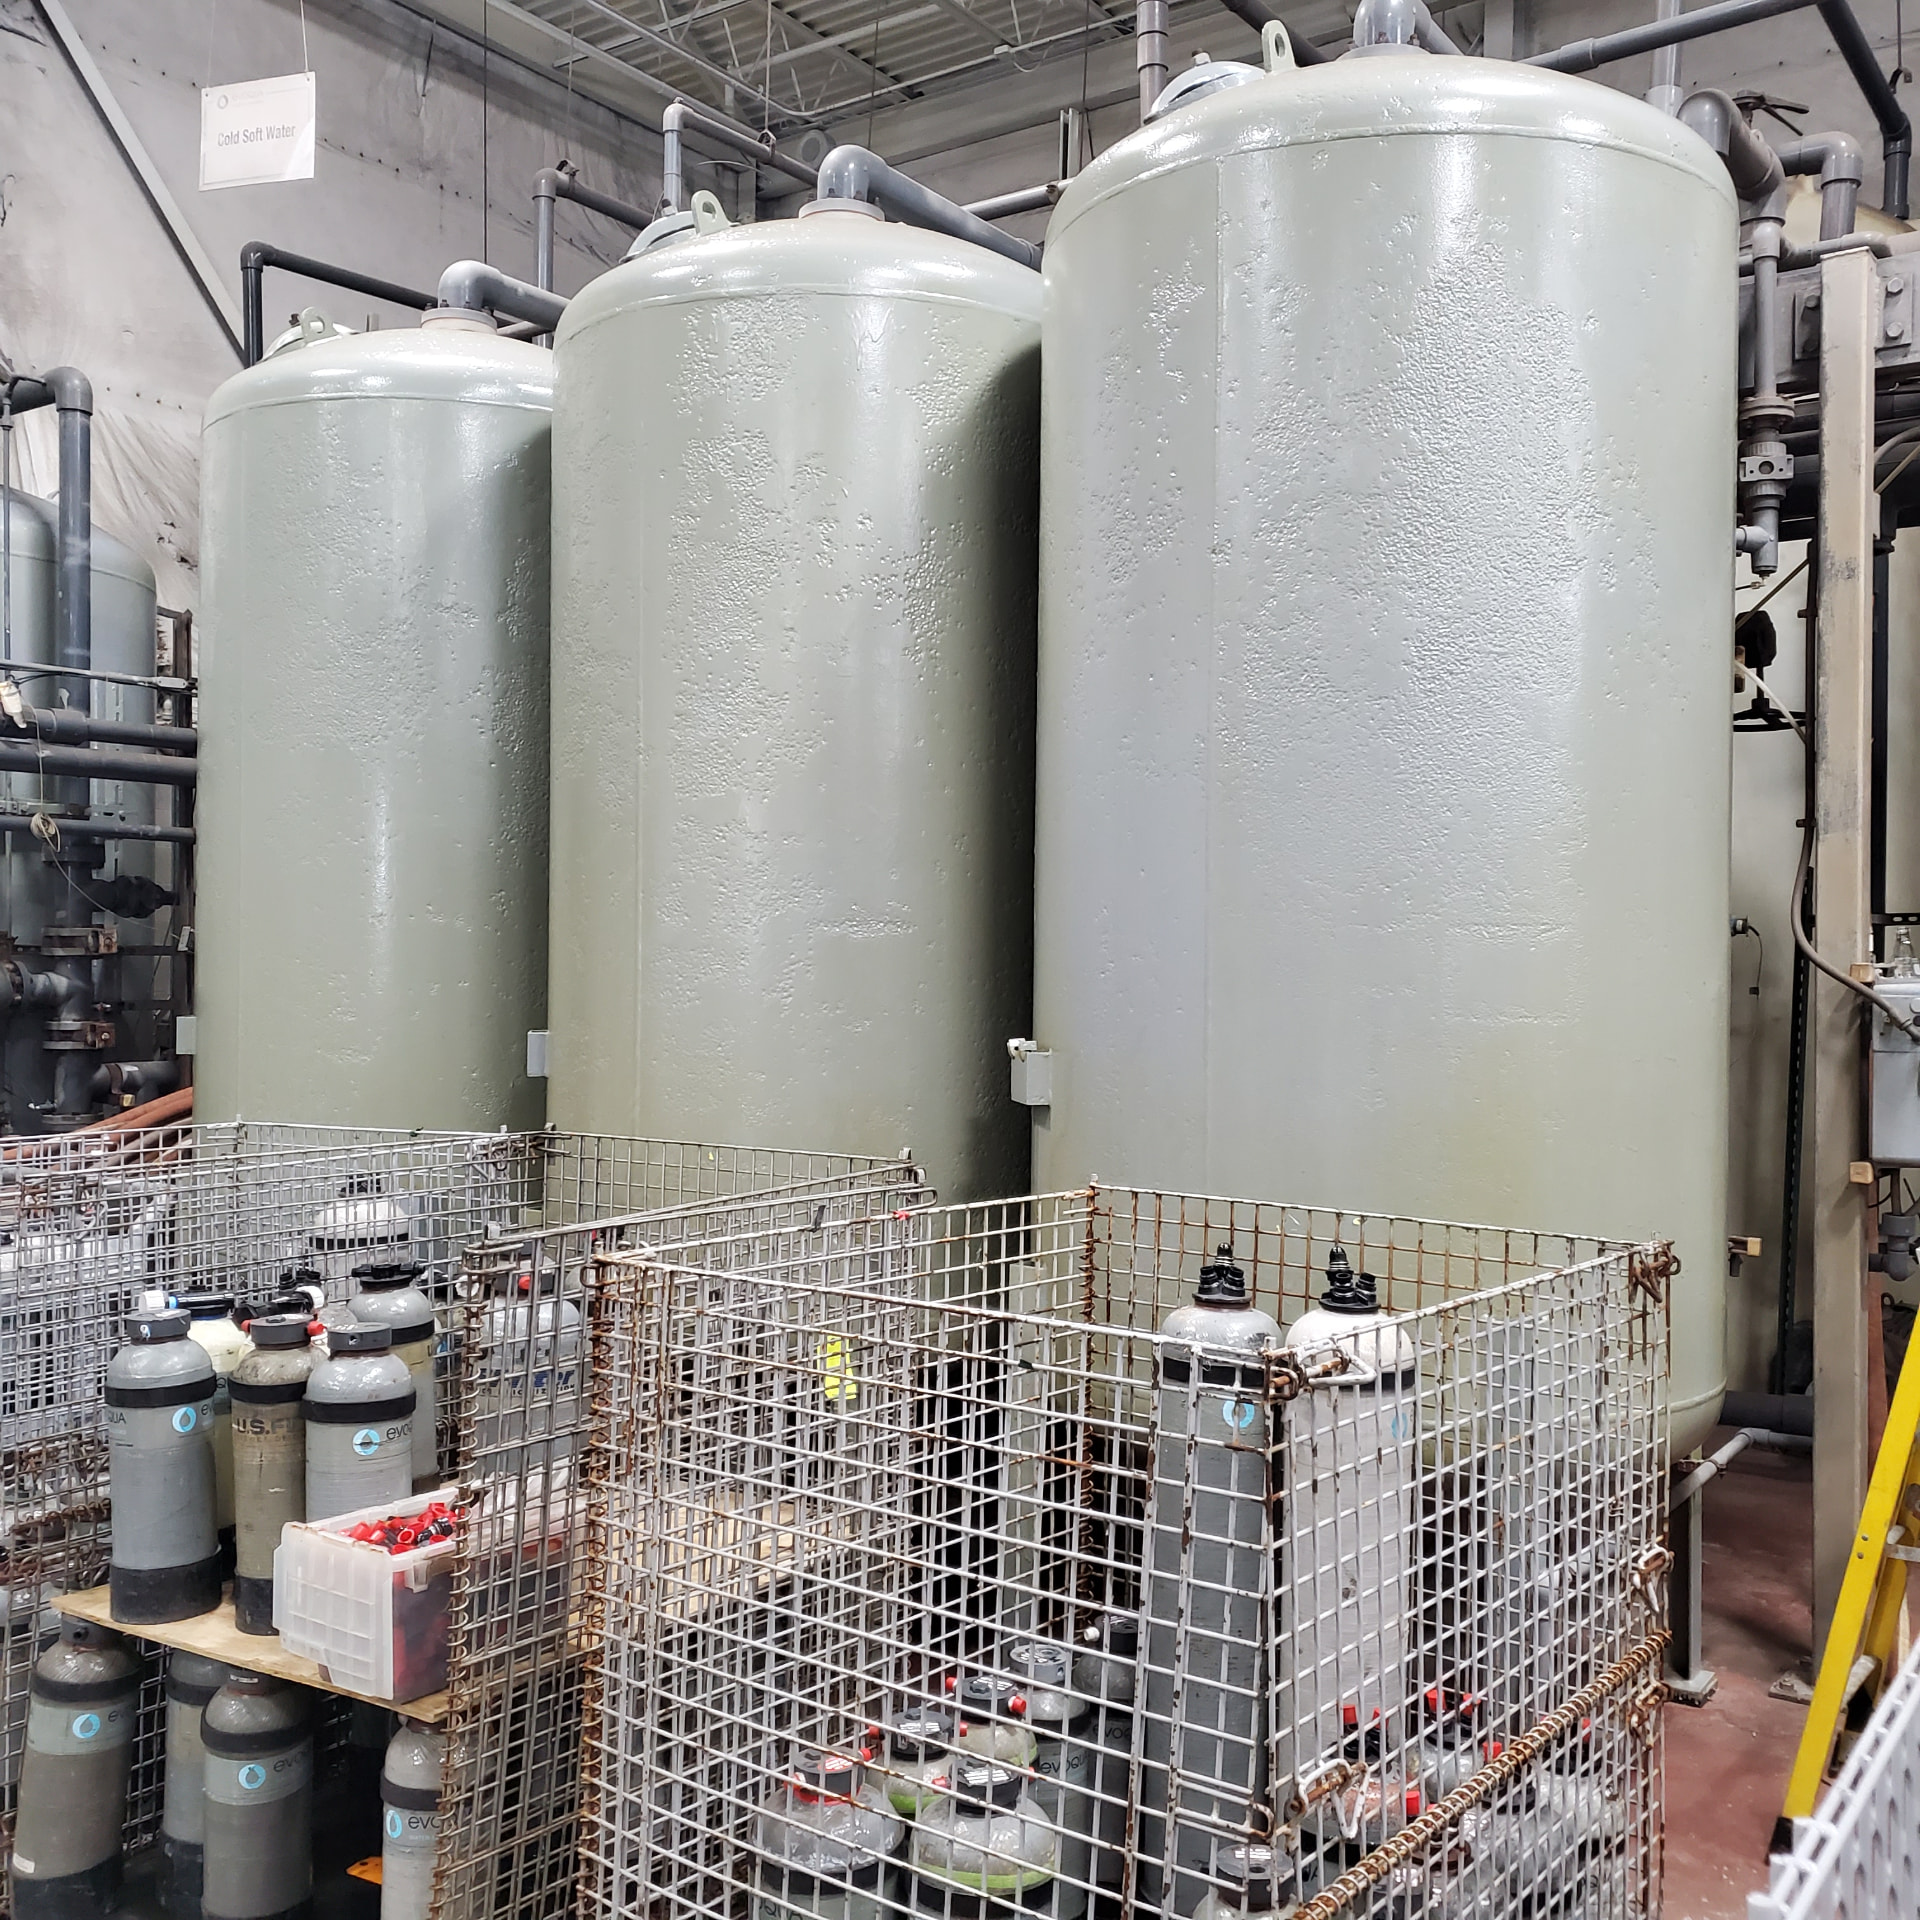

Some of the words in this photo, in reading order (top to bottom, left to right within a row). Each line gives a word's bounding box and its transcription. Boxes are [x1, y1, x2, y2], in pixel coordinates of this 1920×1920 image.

[217, 131, 240, 147] Cold
[242, 127, 263, 144] Soft
[266, 124, 296, 140] Water
